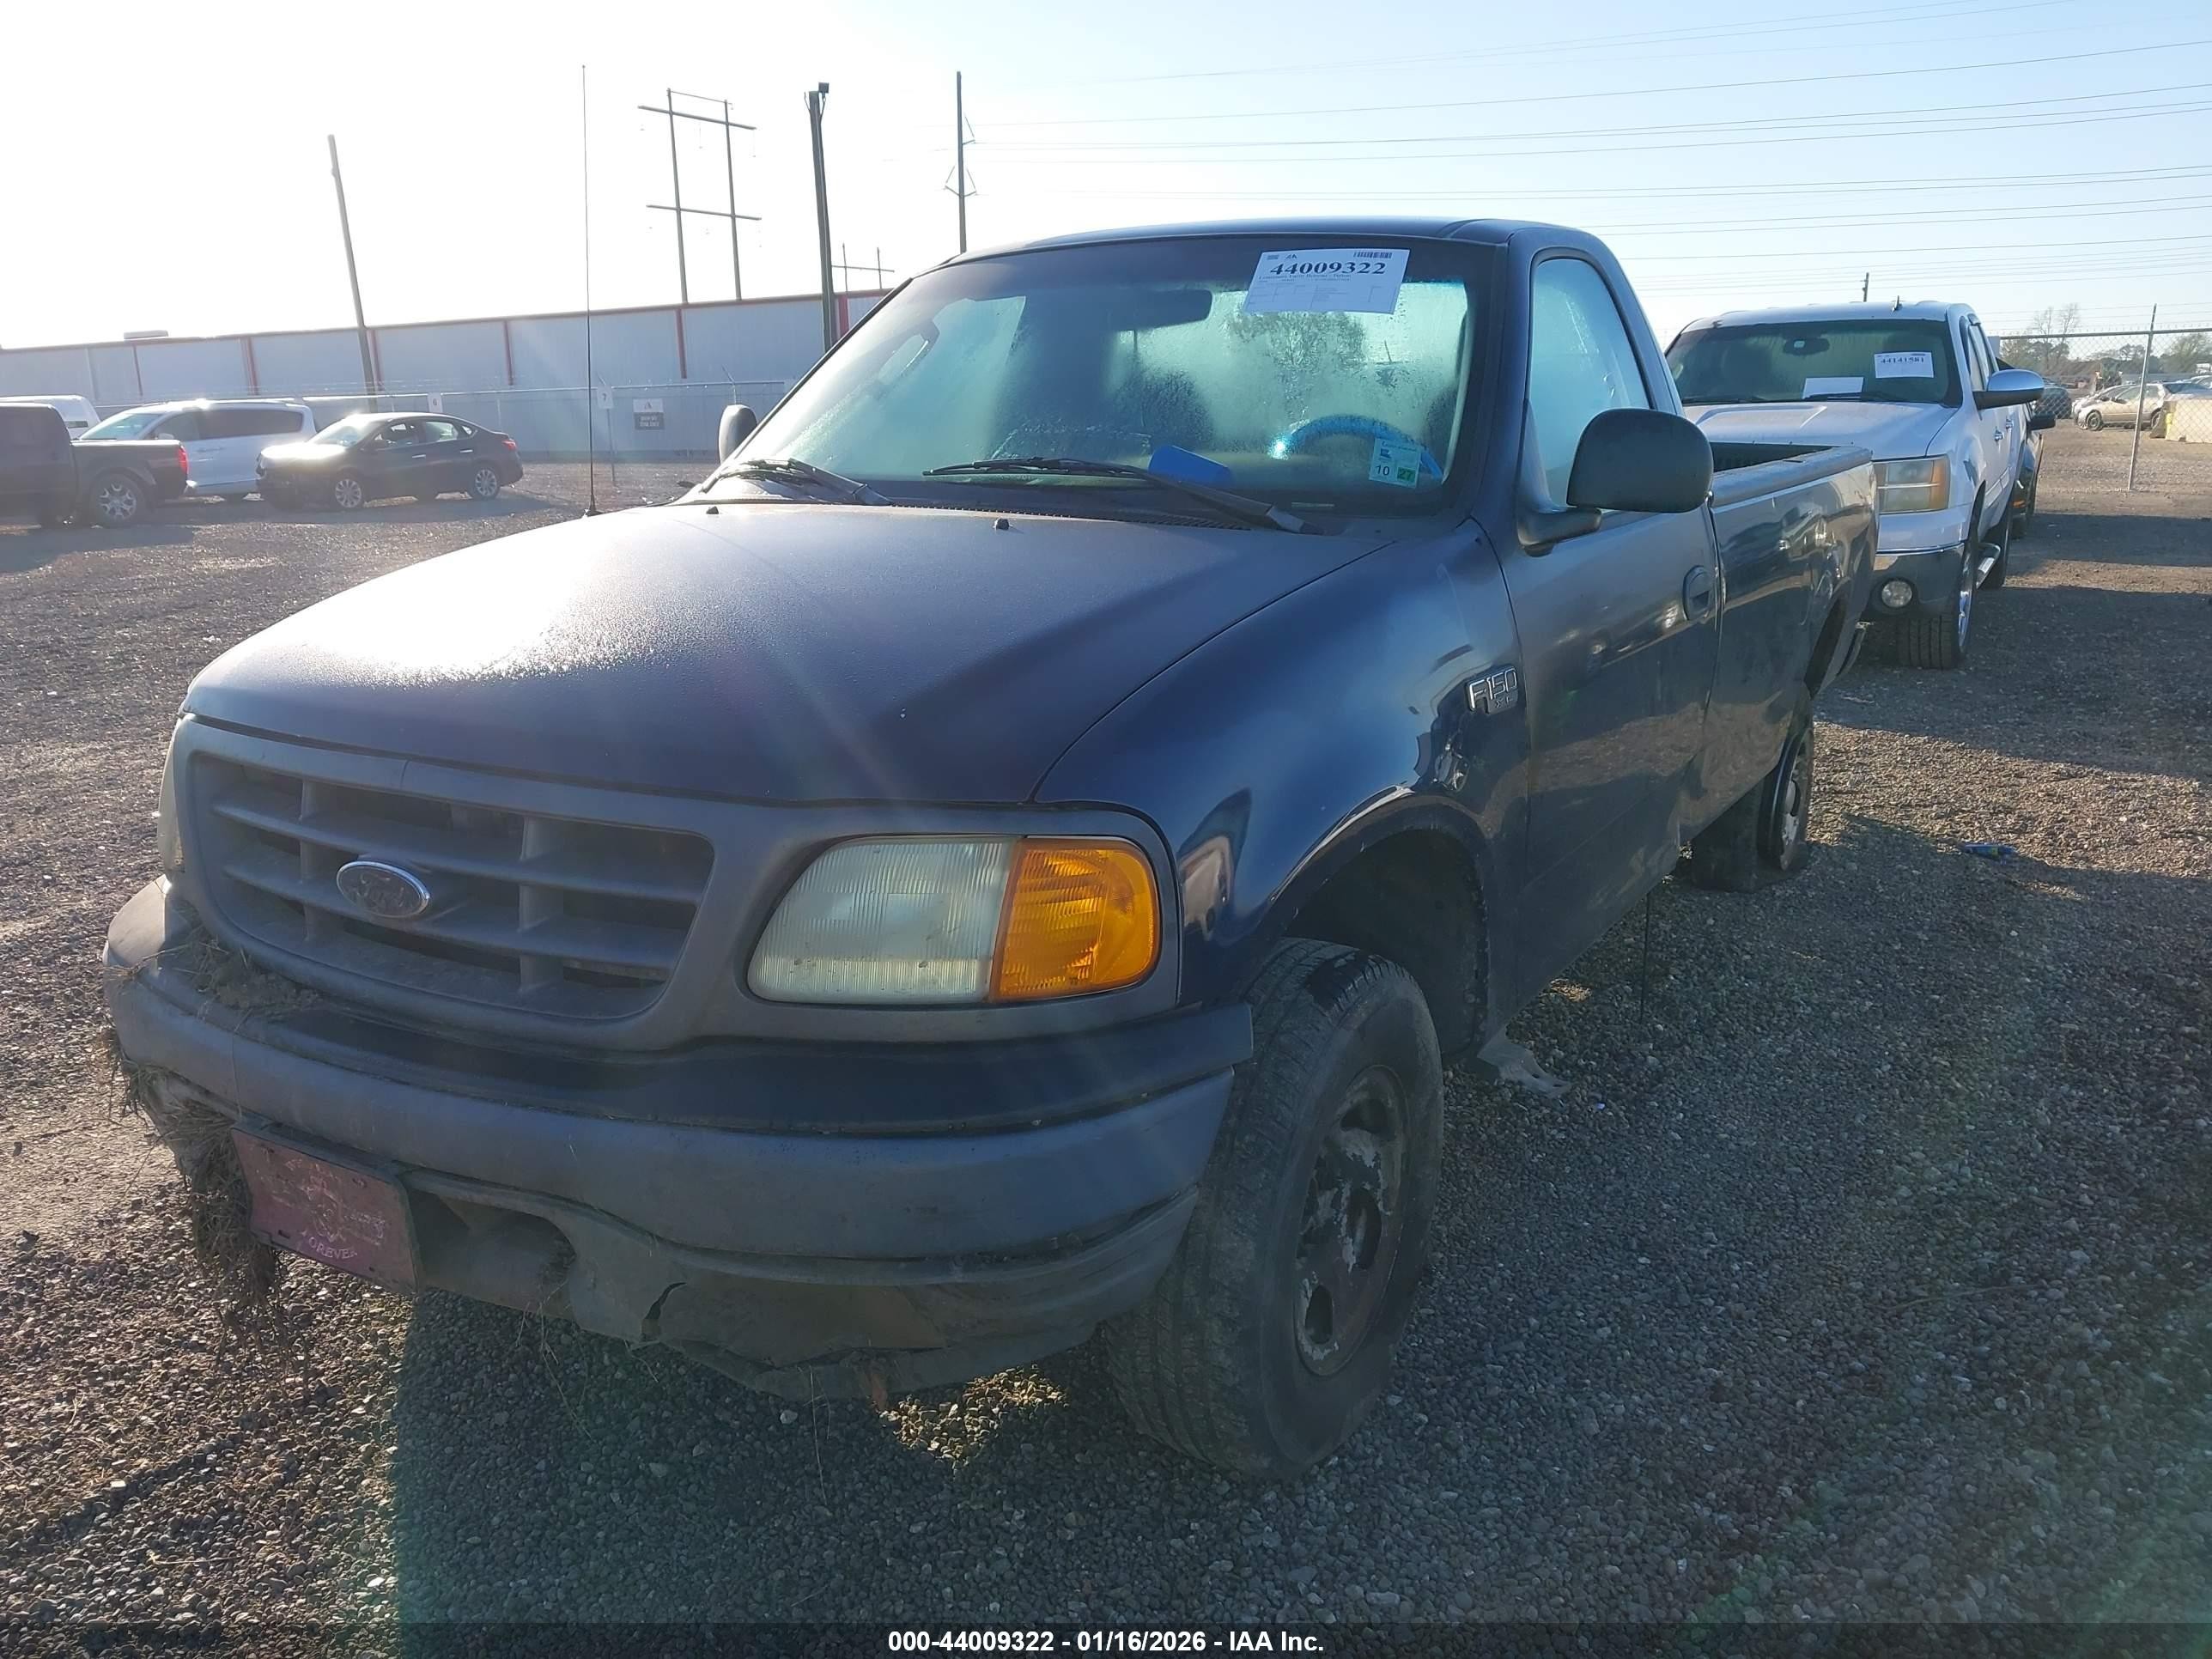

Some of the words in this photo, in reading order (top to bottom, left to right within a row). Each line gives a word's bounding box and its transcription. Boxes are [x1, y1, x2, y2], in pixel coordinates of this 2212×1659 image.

[1270, 261, 1386, 275] 44009322
[1375, 465, 1390, 476] 10
[1400, 468, 1415, 481] 27
[1469, 668, 1517, 709] F150
